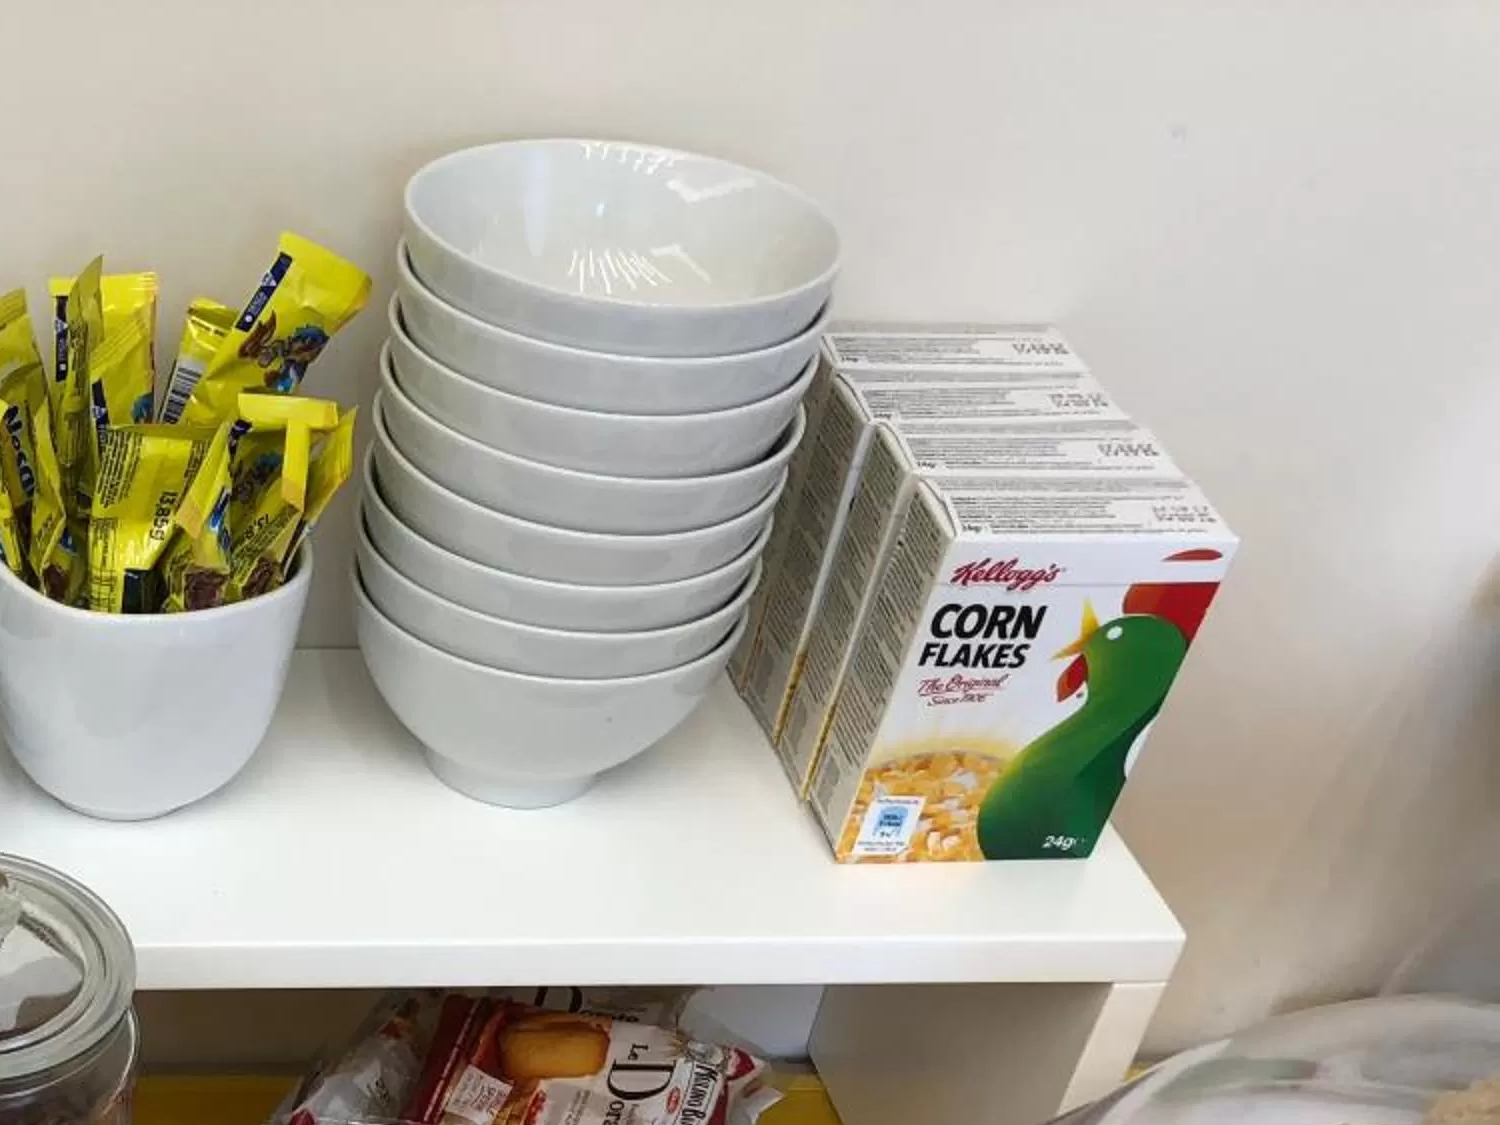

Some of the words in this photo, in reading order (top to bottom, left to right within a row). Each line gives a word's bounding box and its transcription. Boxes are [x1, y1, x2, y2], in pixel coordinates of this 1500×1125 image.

[950, 558, 1061, 591] Kellogg's
[930, 603, 1048, 640] CORN
[918, 641, 1031, 668] FLAKES
[628, 1043, 649, 1060] Le
